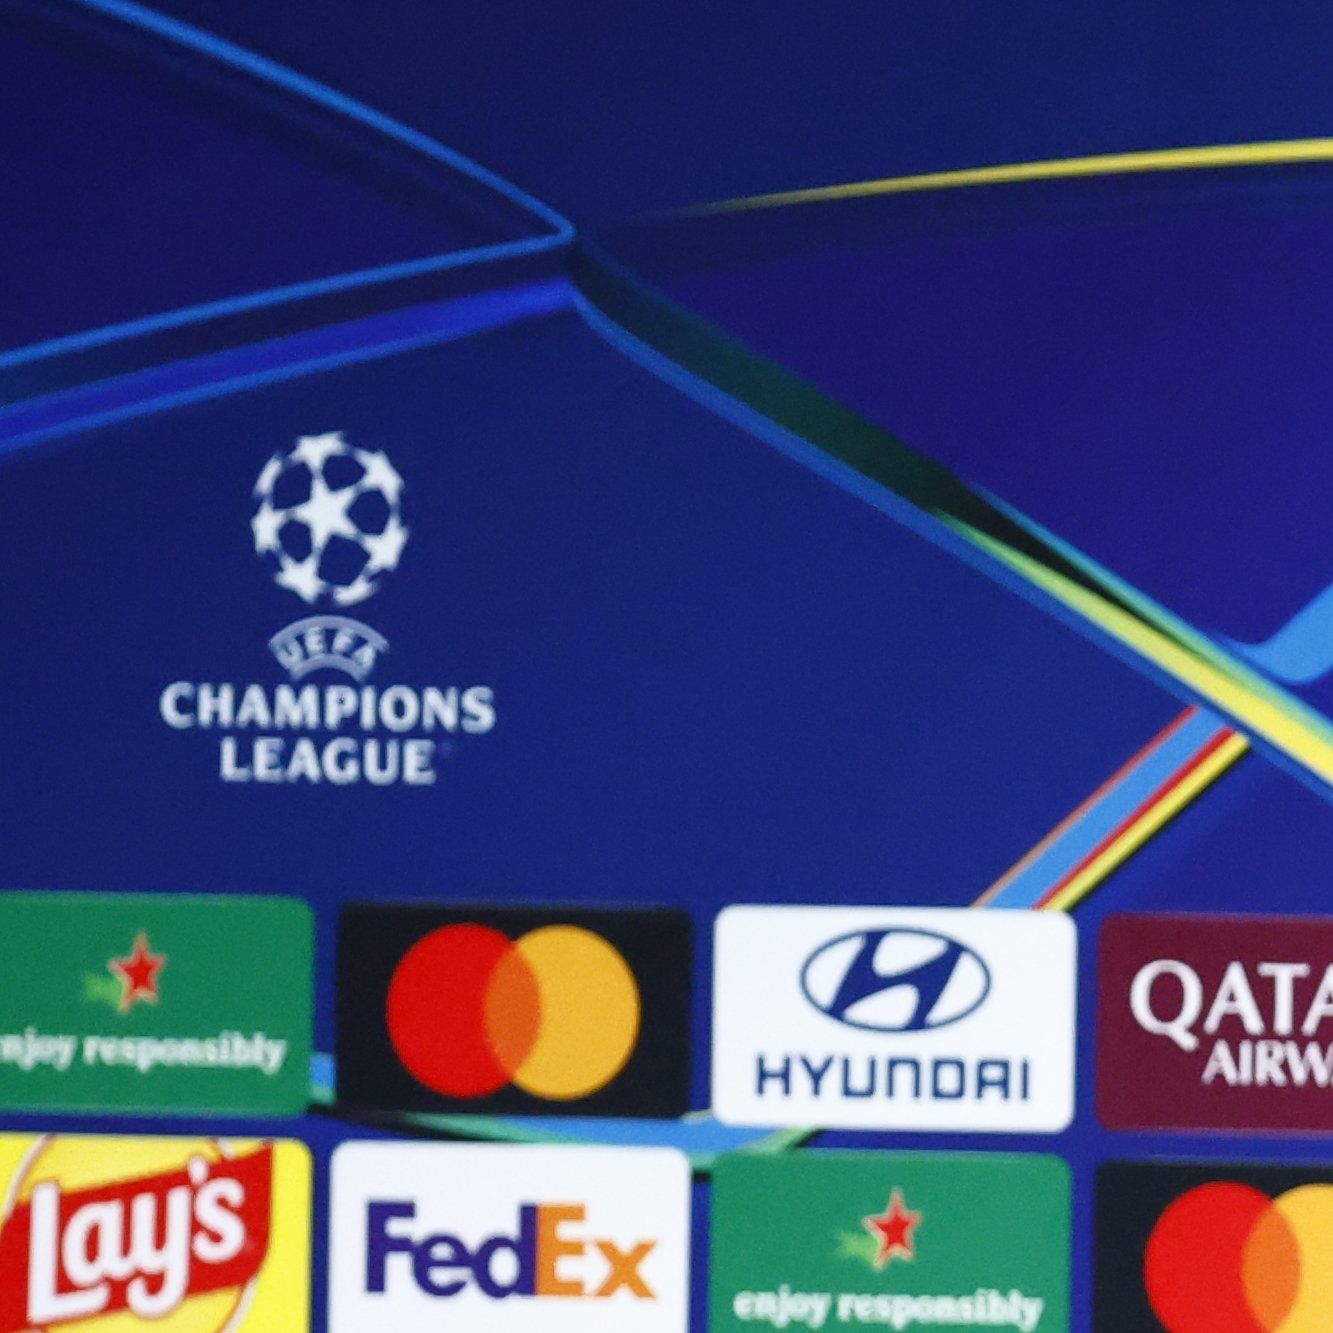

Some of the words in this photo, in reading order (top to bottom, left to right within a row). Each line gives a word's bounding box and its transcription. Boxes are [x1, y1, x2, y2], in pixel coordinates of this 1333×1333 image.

[160, 682, 495, 733] CHAMPIONS
[221, 737, 434, 784] LEAGUE
[0, 1027, 77, 1070] njoy
[83, 1031, 286, 1074] responsibly
[756, 1055, 1029, 1100] HYUNDAI
[27, 1155, 245, 1323] Lay's
[365, 1199, 655, 1300] FedEx
[733, 1285, 834, 1328] enjoy
[837, 1289, 1044, 1333] responsibly
